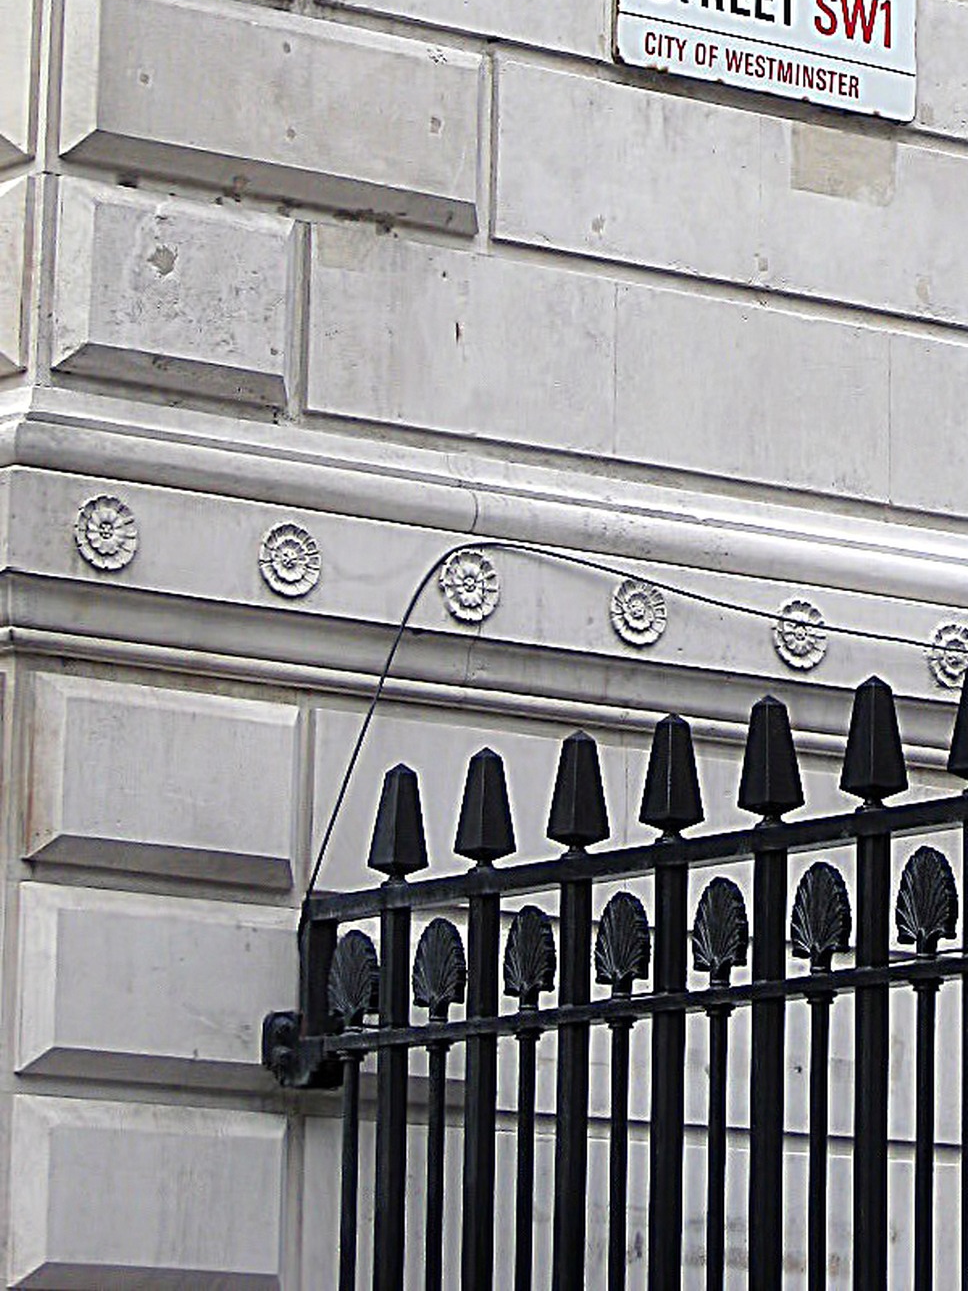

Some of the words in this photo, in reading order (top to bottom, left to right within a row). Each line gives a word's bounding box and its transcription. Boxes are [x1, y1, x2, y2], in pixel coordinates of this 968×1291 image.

[644, 32, 687, 60] CITY
[695, 43, 719, 69] OF
[725, 48, 860, 99] WESTMINSTER
